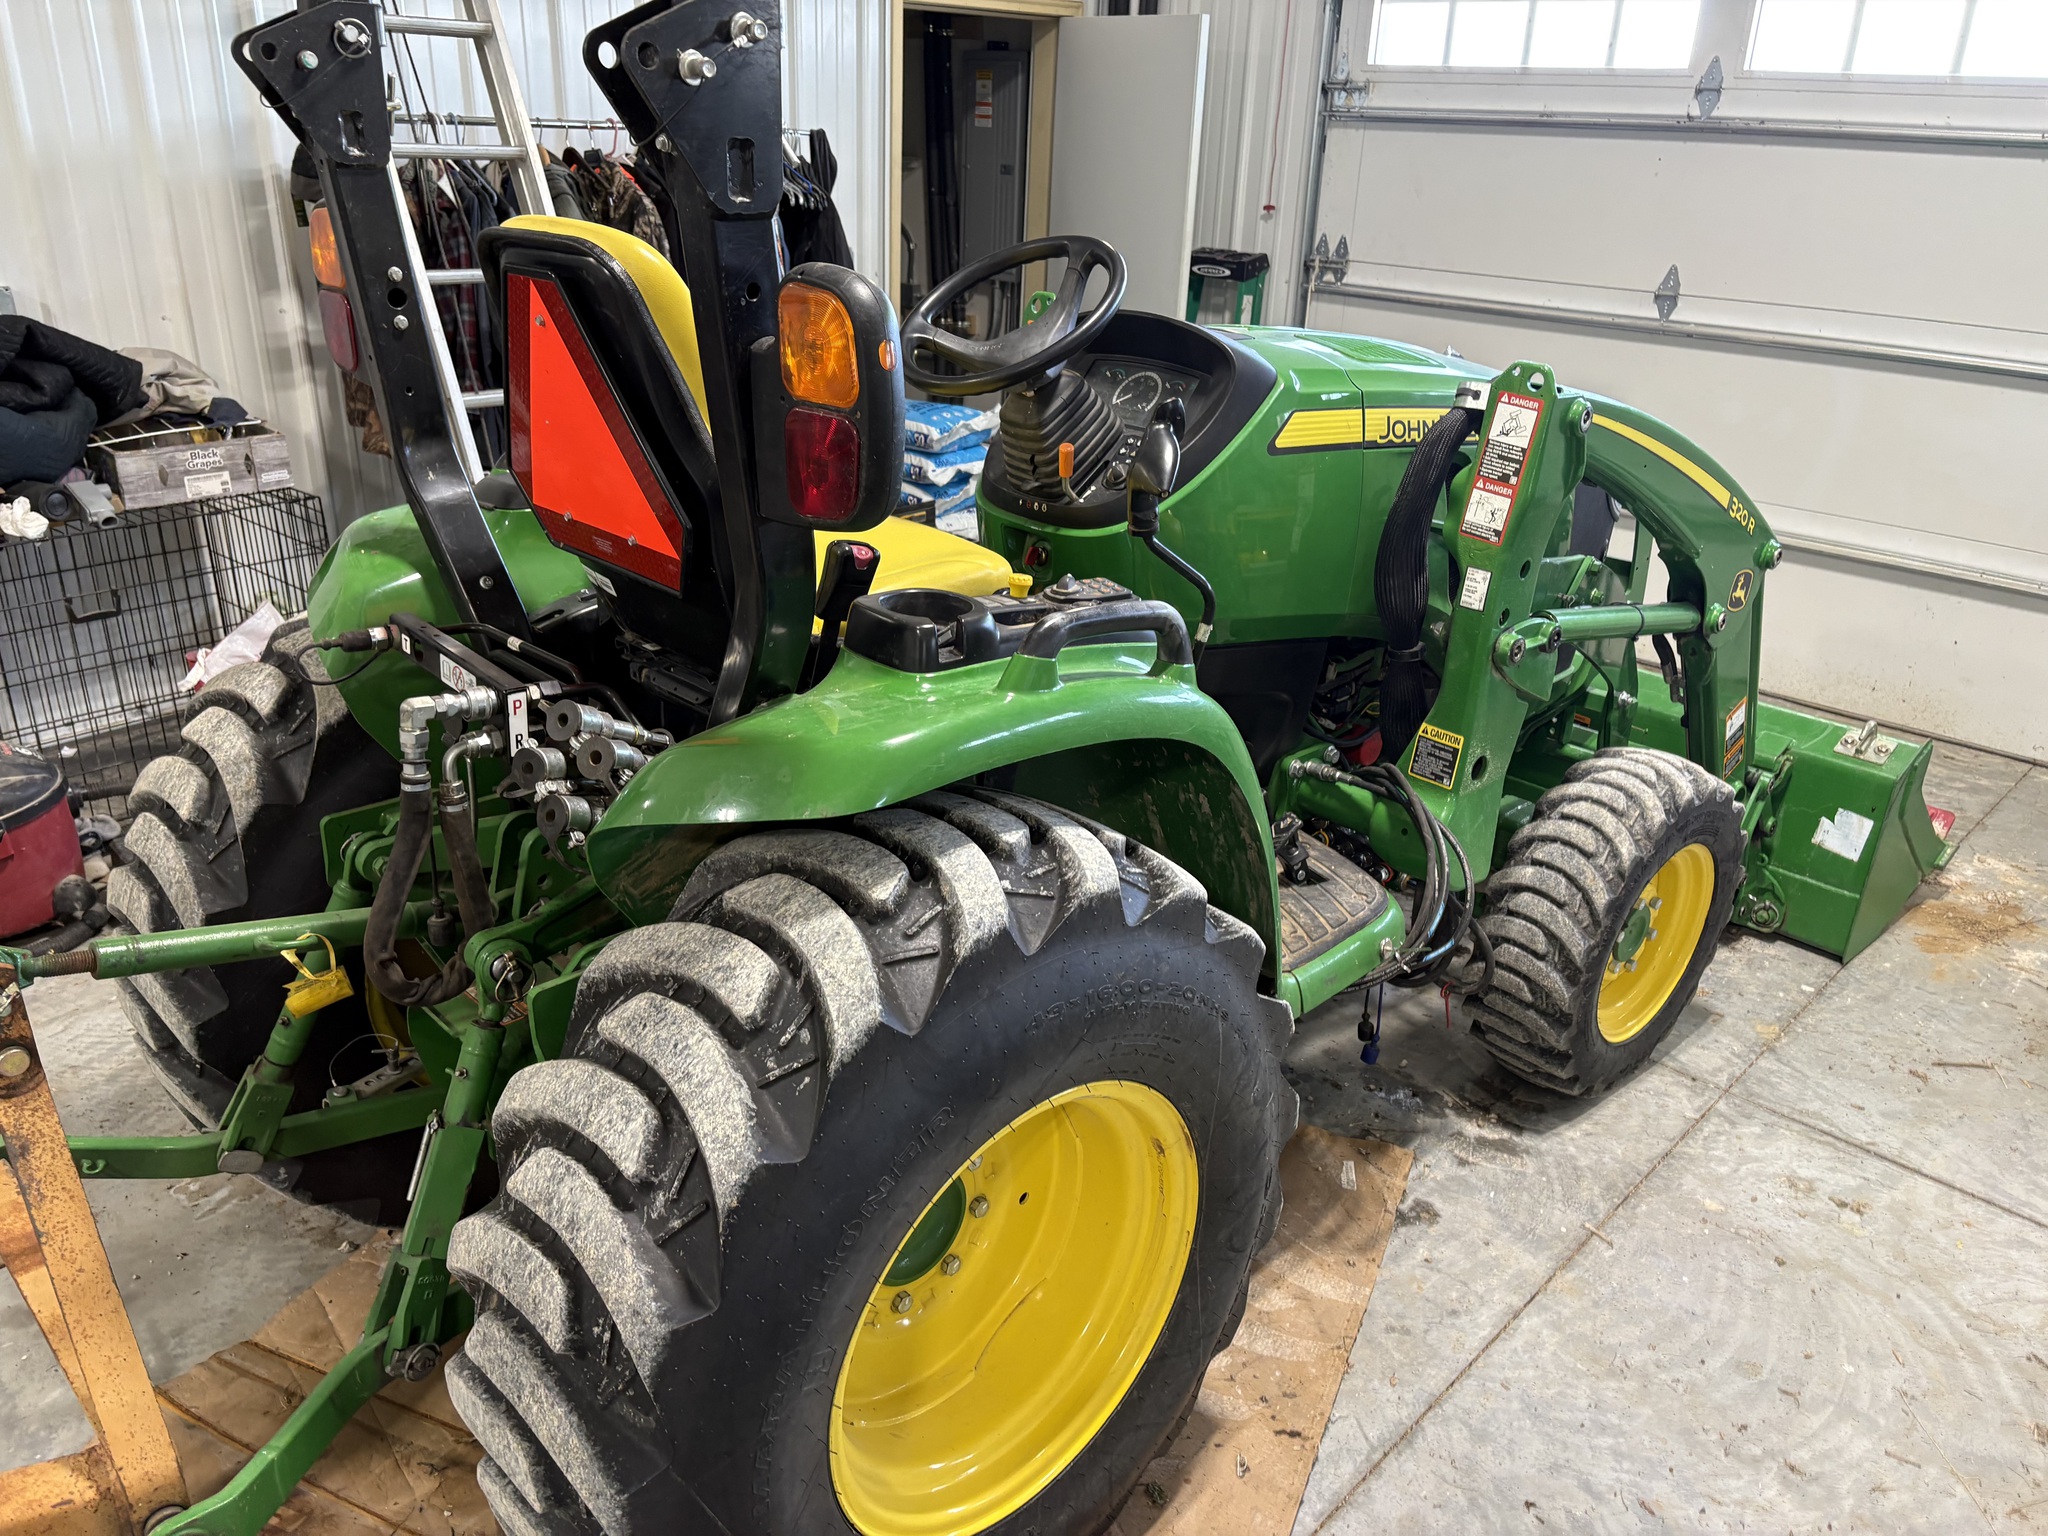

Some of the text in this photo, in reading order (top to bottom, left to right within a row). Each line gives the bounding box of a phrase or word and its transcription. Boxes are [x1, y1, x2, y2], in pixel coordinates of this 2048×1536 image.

[1510, 396, 1539, 410] DANGER
[190, 448, 219, 460] Black
[187, 460, 222, 470] Grapes
[1485, 482, 1513, 496] DANGER
[1729, 496, 1756, 536] 320 R
[403, 637, 409, 650] T
[513, 699, 522, 716] P
[515, 733, 524, 749] R
[1430, 728, 1462, 747] CAUTION
